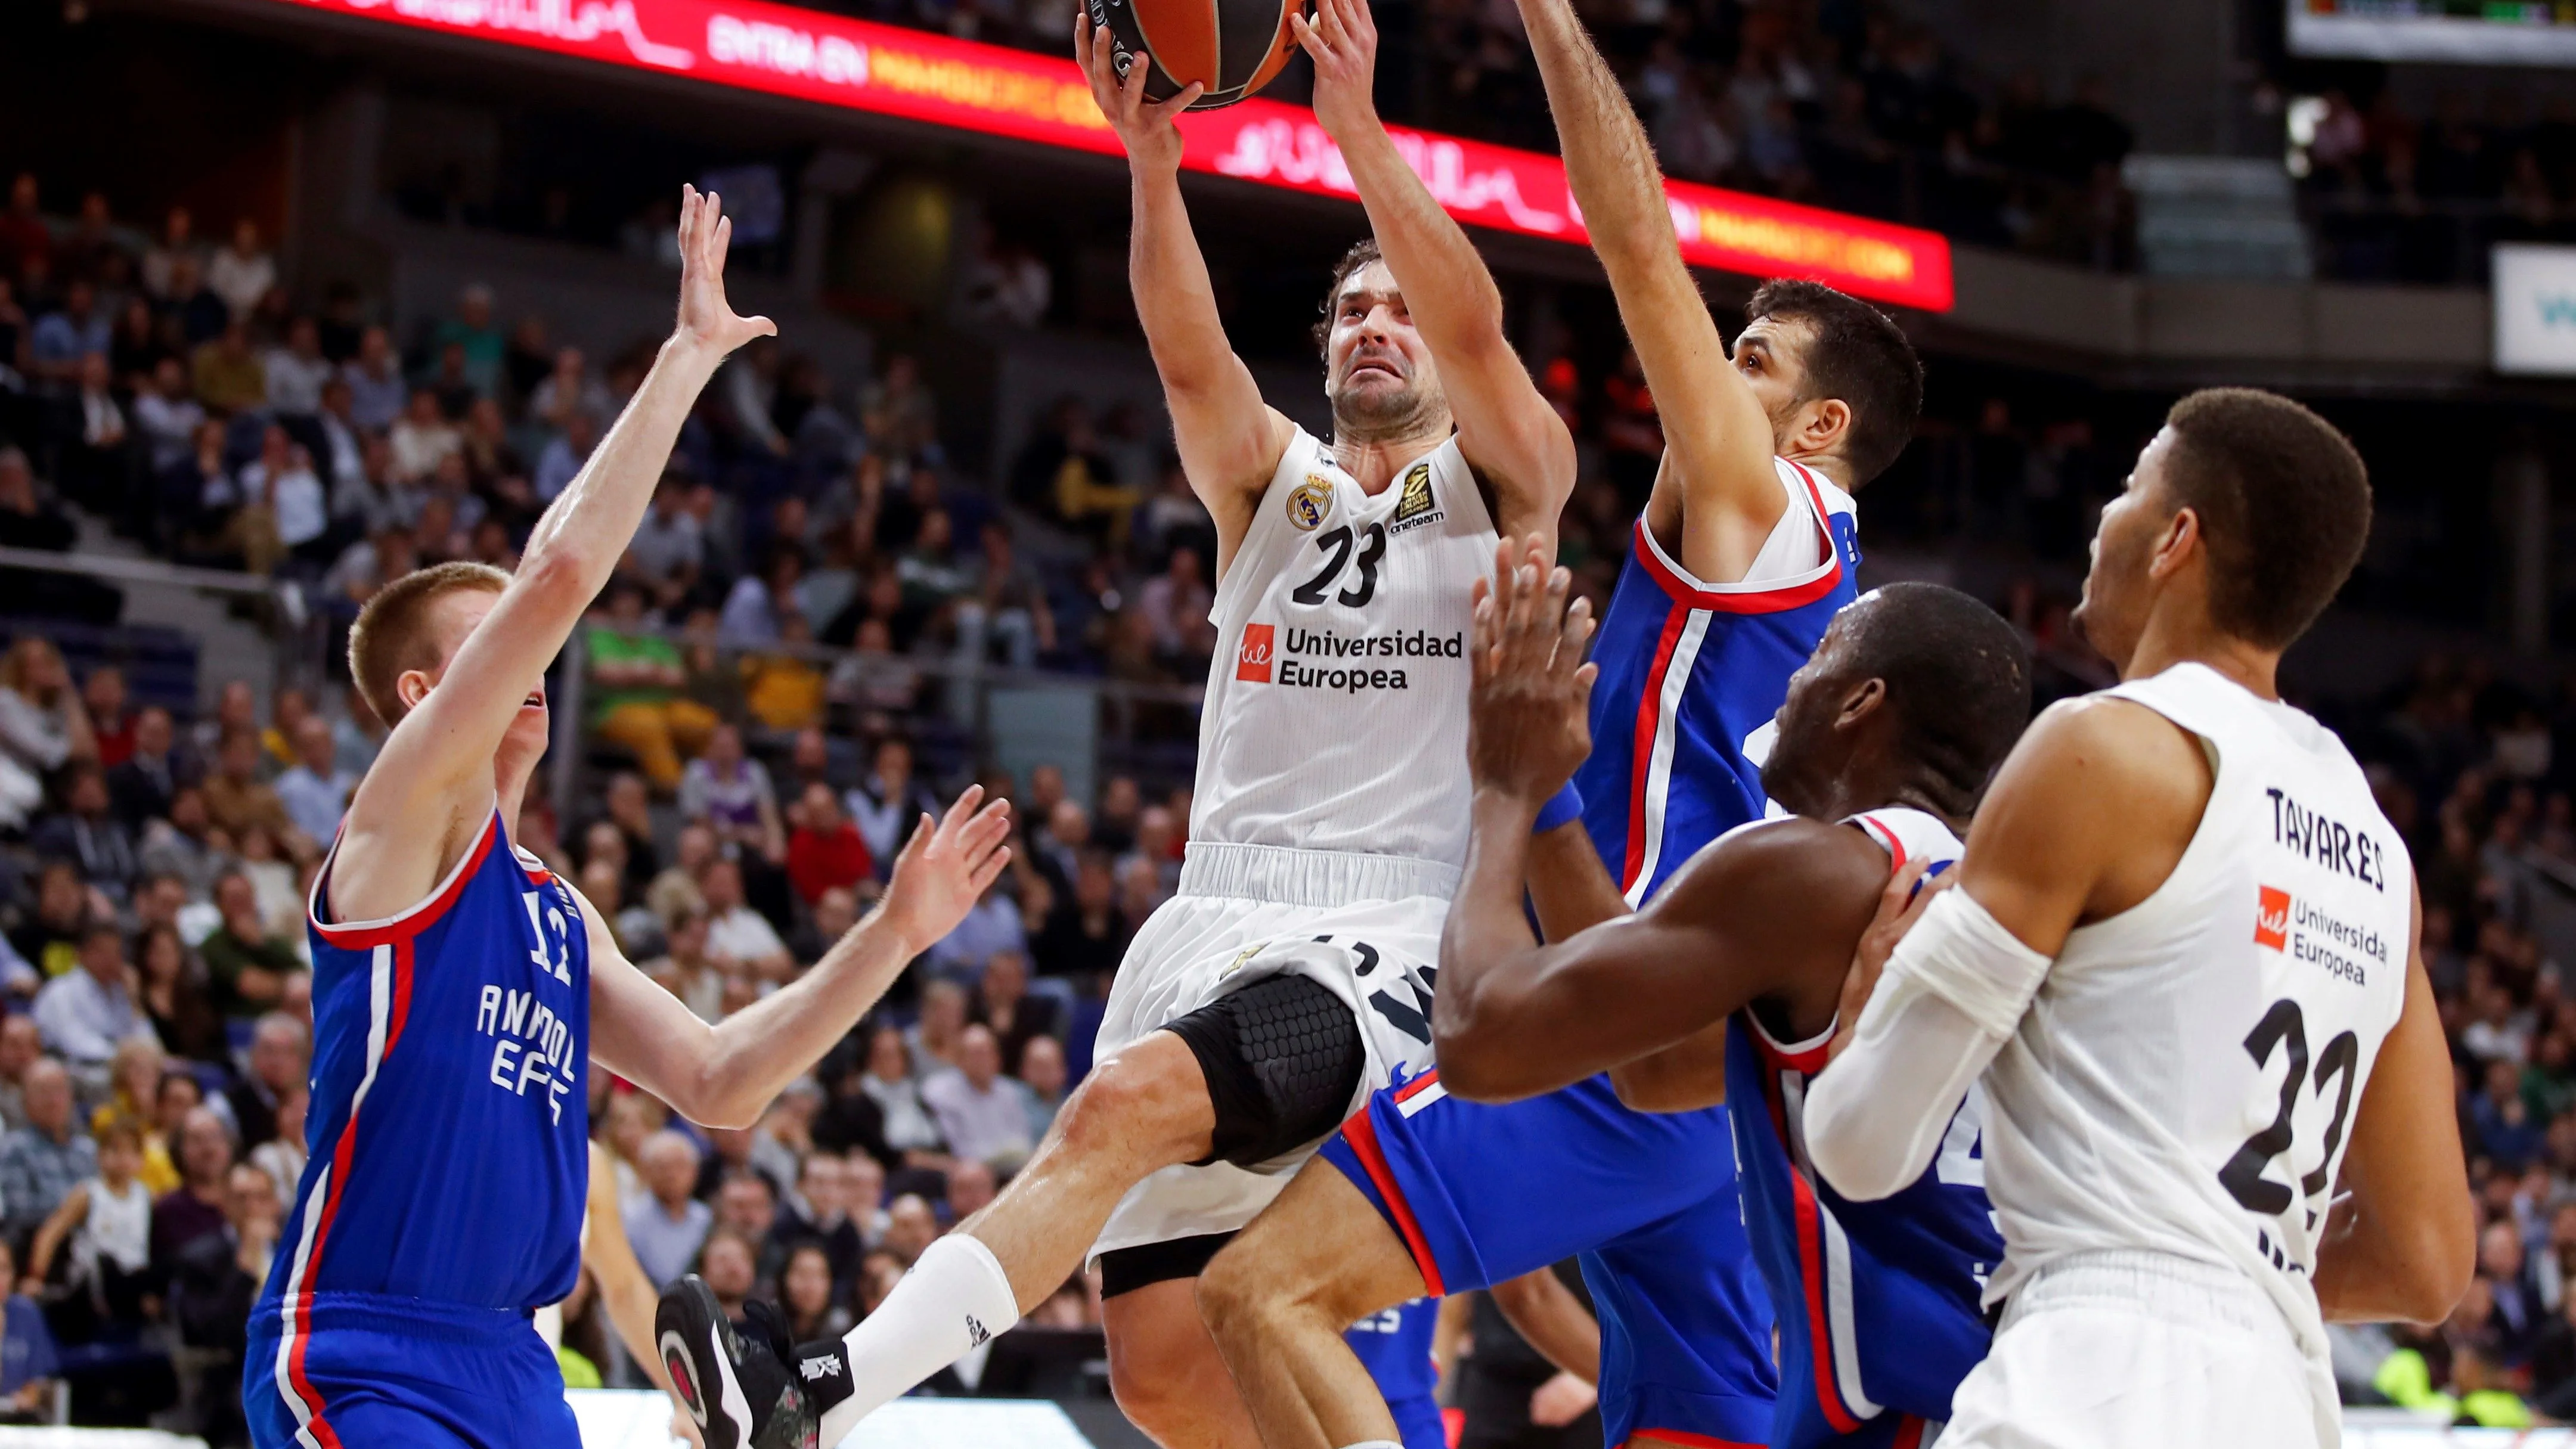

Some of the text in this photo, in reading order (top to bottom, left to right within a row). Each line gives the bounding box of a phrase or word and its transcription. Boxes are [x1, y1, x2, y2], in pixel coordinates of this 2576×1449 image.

[1390, 511, 1444, 534] oneteam
[1292, 522, 1386, 608] 23
[1286, 628, 1462, 659] Universidad
[1279, 660, 1408, 694] Europea
[2266, 787, 2383, 893] TAVARES
[522, 891, 571, 987] 12
[2293, 933, 2366, 986] Europea
[2295, 899, 2387, 964] Universida
[2218, 998, 2358, 1231] 22
